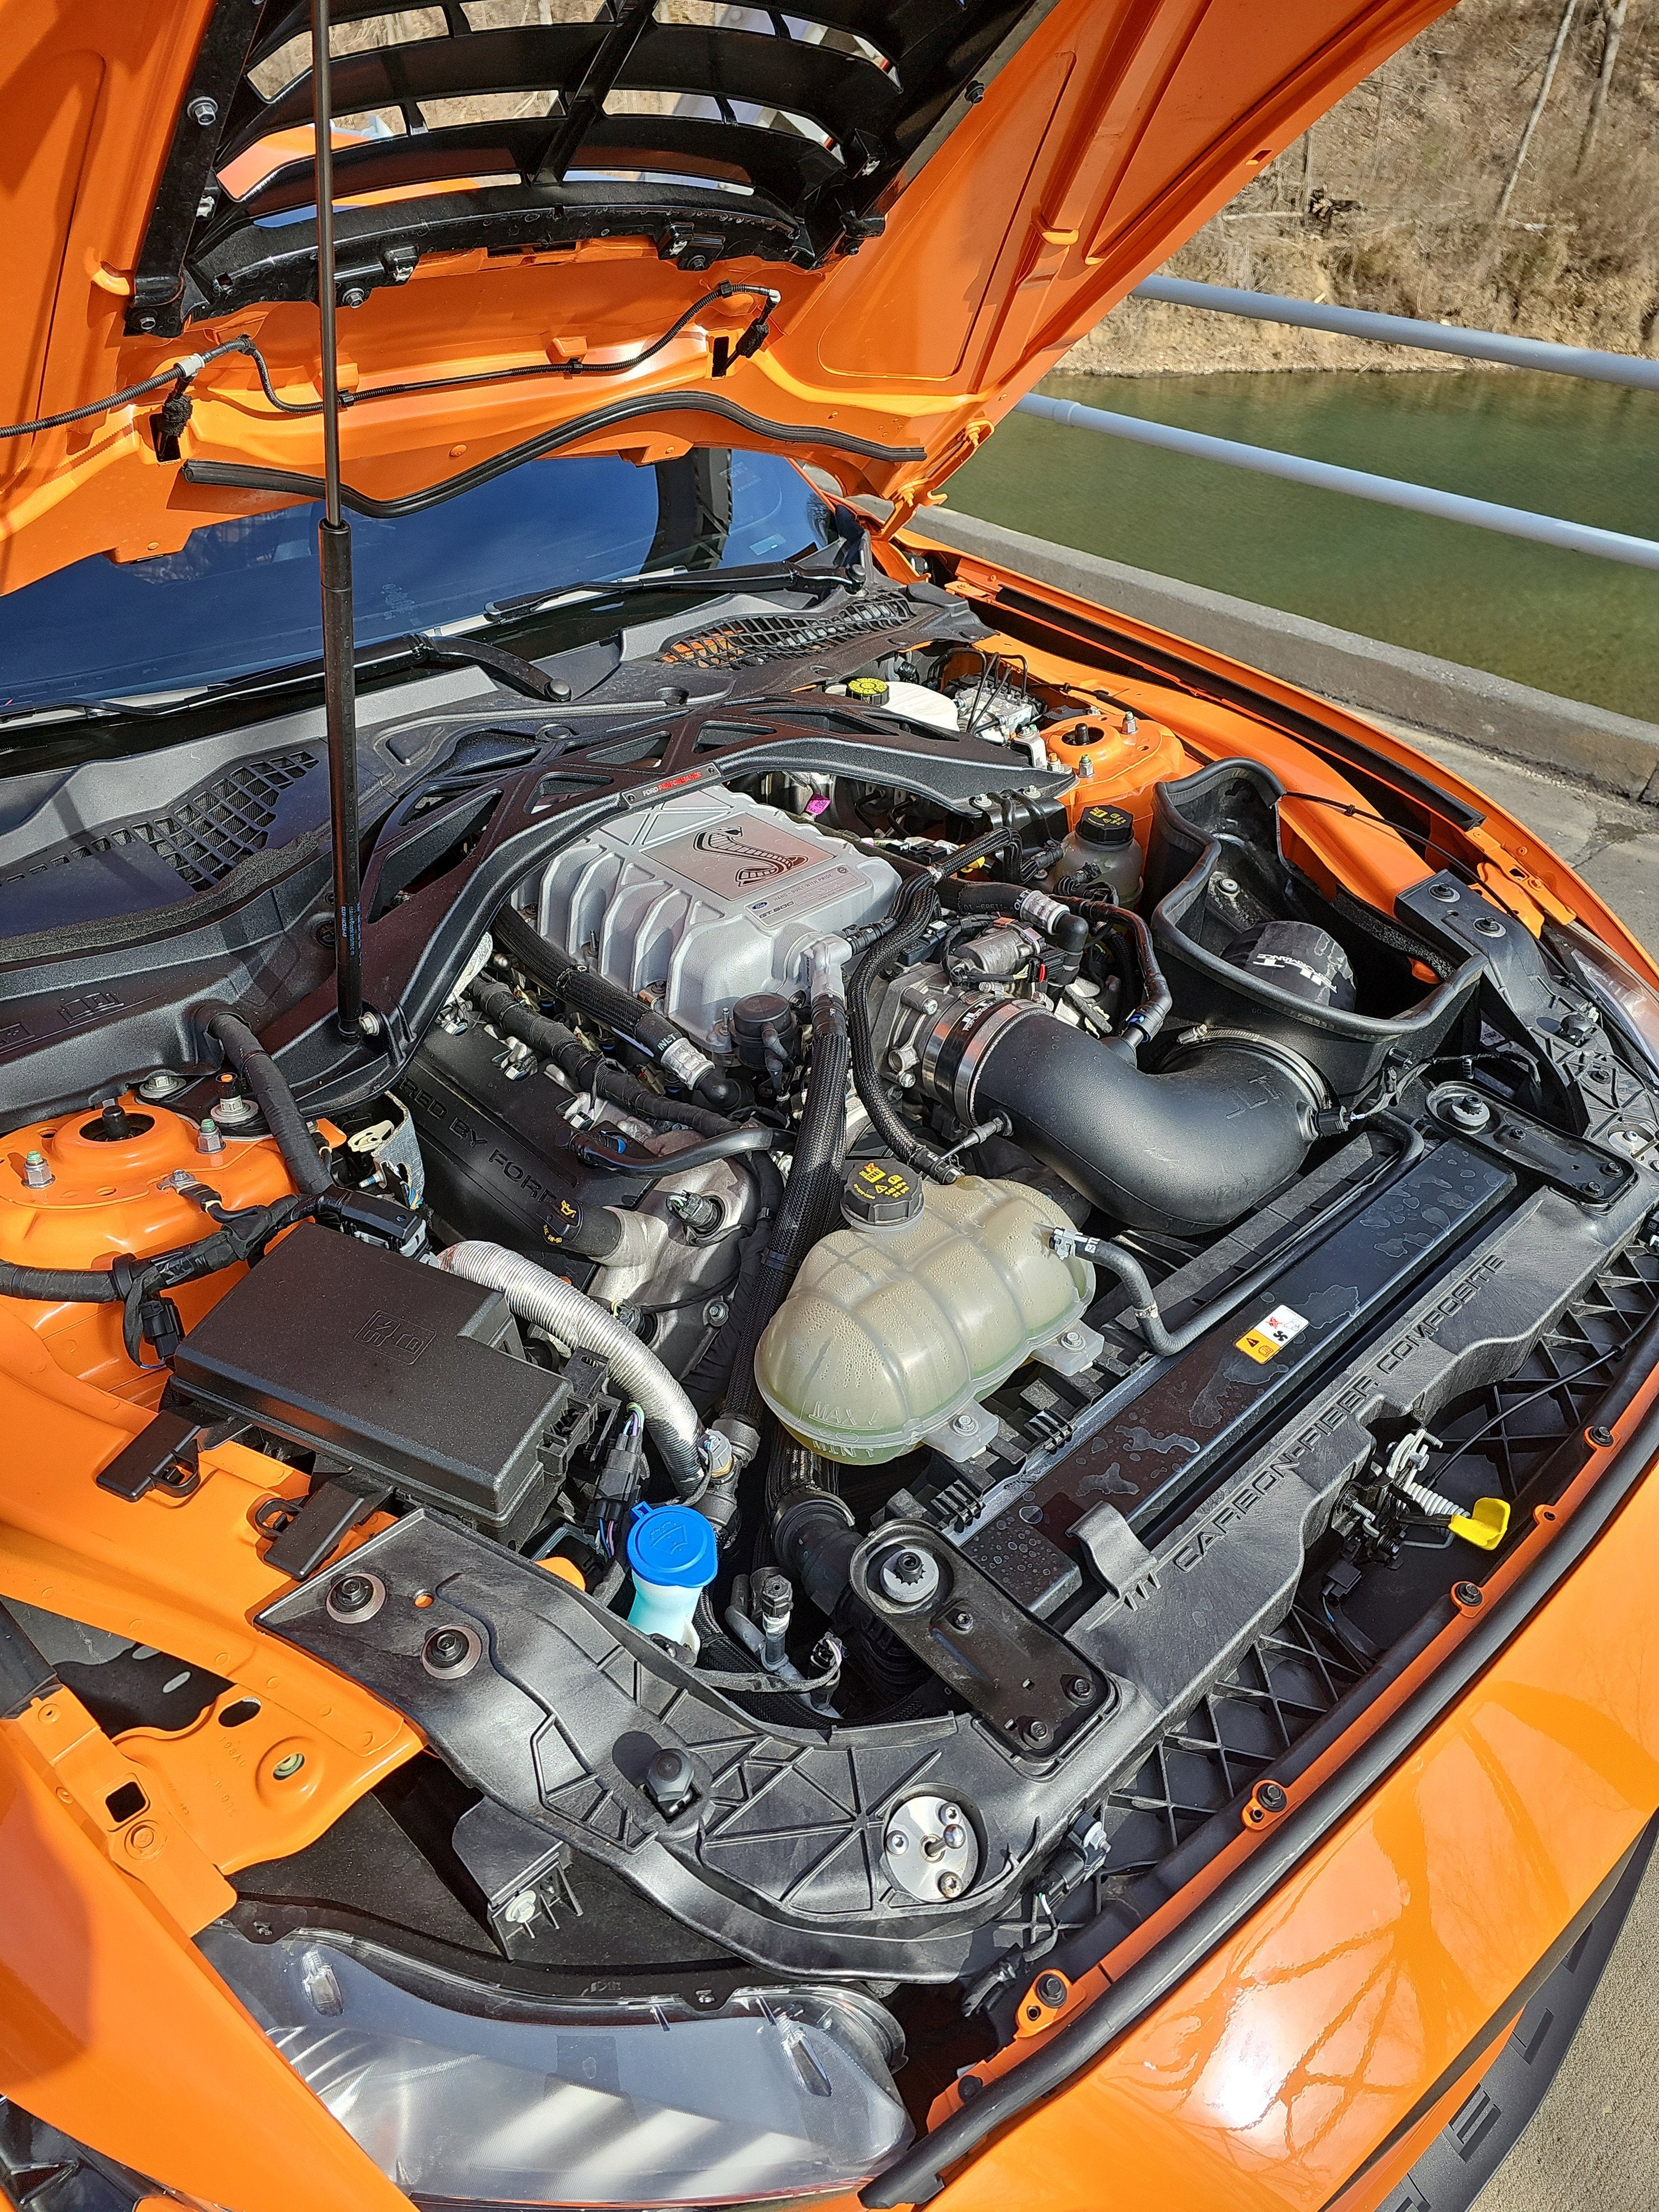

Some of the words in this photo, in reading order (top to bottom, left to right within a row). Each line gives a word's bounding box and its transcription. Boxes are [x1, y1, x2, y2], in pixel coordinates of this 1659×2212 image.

[642, 787, 658, 796] FORD
[658, 771, 702, 790] PERFORMANCE
[819, 873, 833, 882] PRIDE
[962, 1000, 988, 1030] JLT
[449, 1116, 487, 1148] BY
[547, 1234, 562, 1243] 5W-50
[814, 1400, 857, 1426] MAX
[1173, 1374, 1381, 1573] CARBON-FIBER
[1376, 1254, 1506, 1375] COMPOSITE
[812, 1440, 857, 1458] MIN
